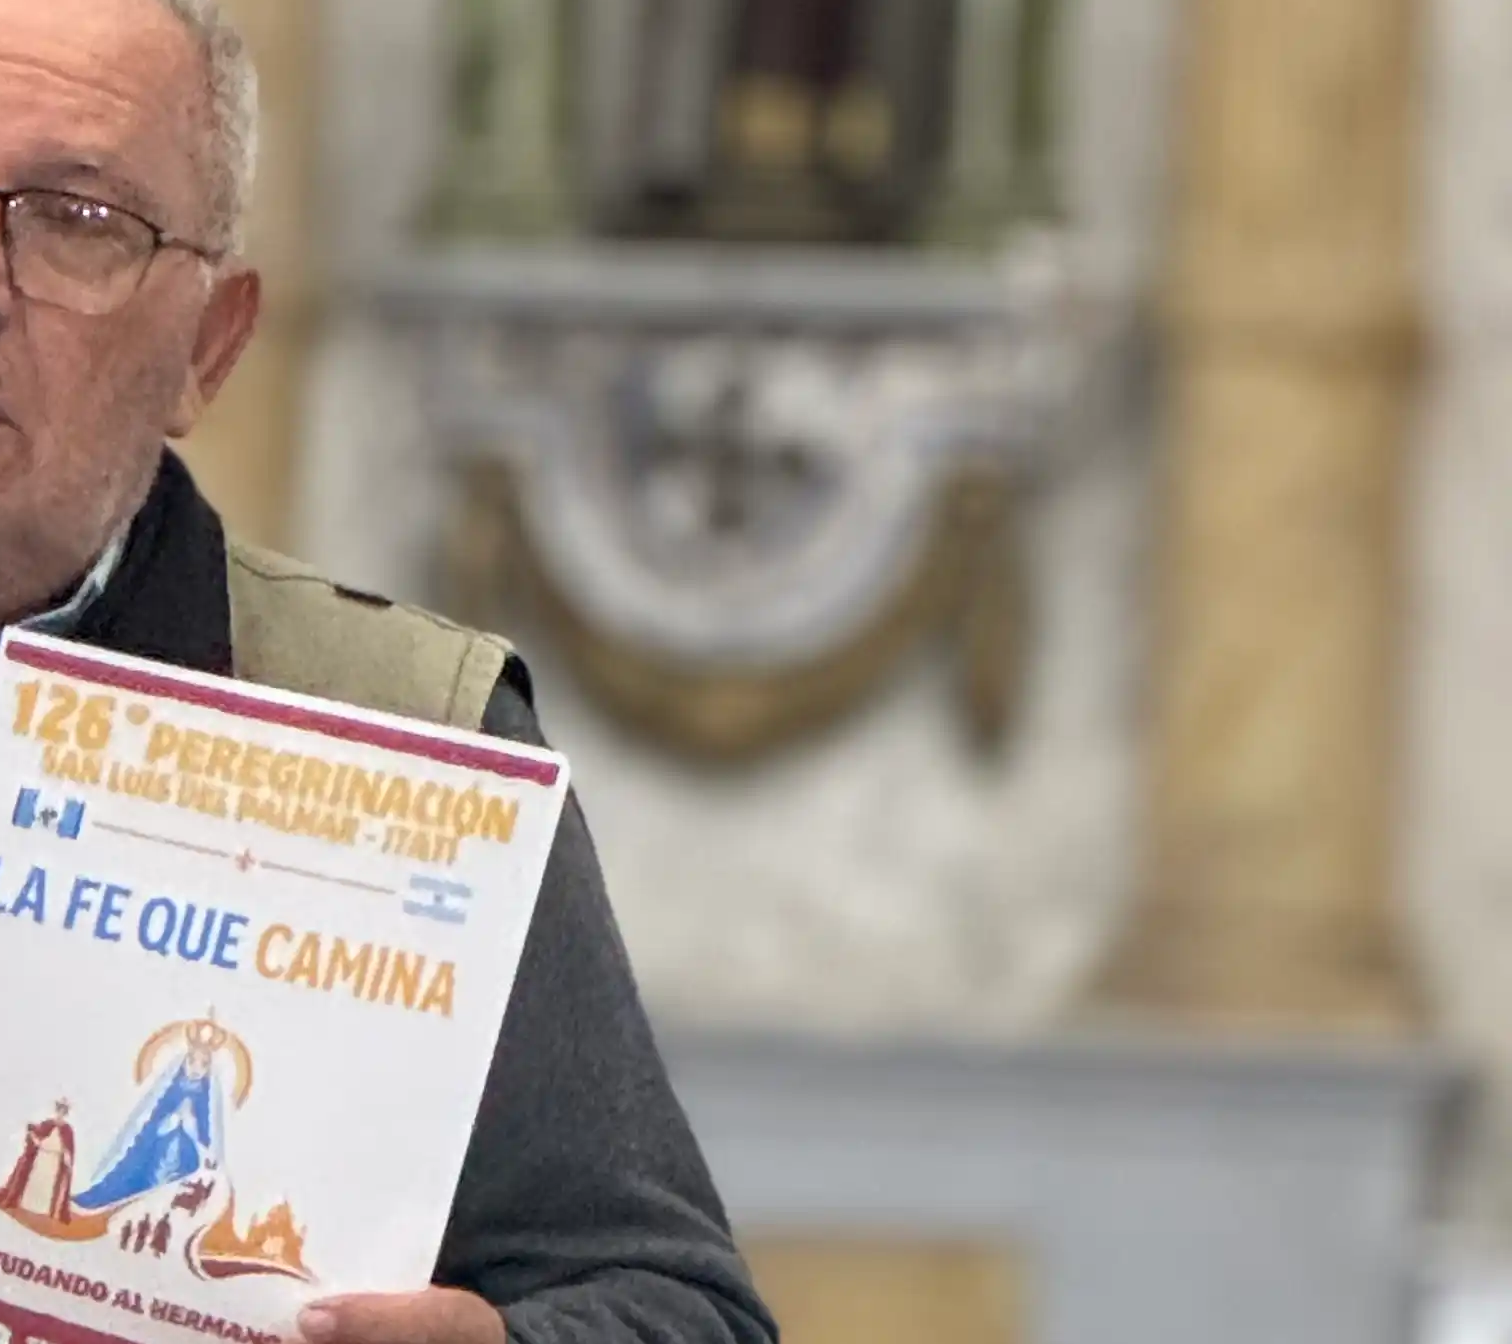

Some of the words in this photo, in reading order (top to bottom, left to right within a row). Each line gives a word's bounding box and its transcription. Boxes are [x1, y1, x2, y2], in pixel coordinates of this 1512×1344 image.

[145, 722, 519, 844] PEREGRINACIÓN
[63, 875, 132, 943] FE
[138, 897, 250, 970] QUE
[255, 923, 457, 1018] CAMINA
[111, 1289, 145, 1316] AL
